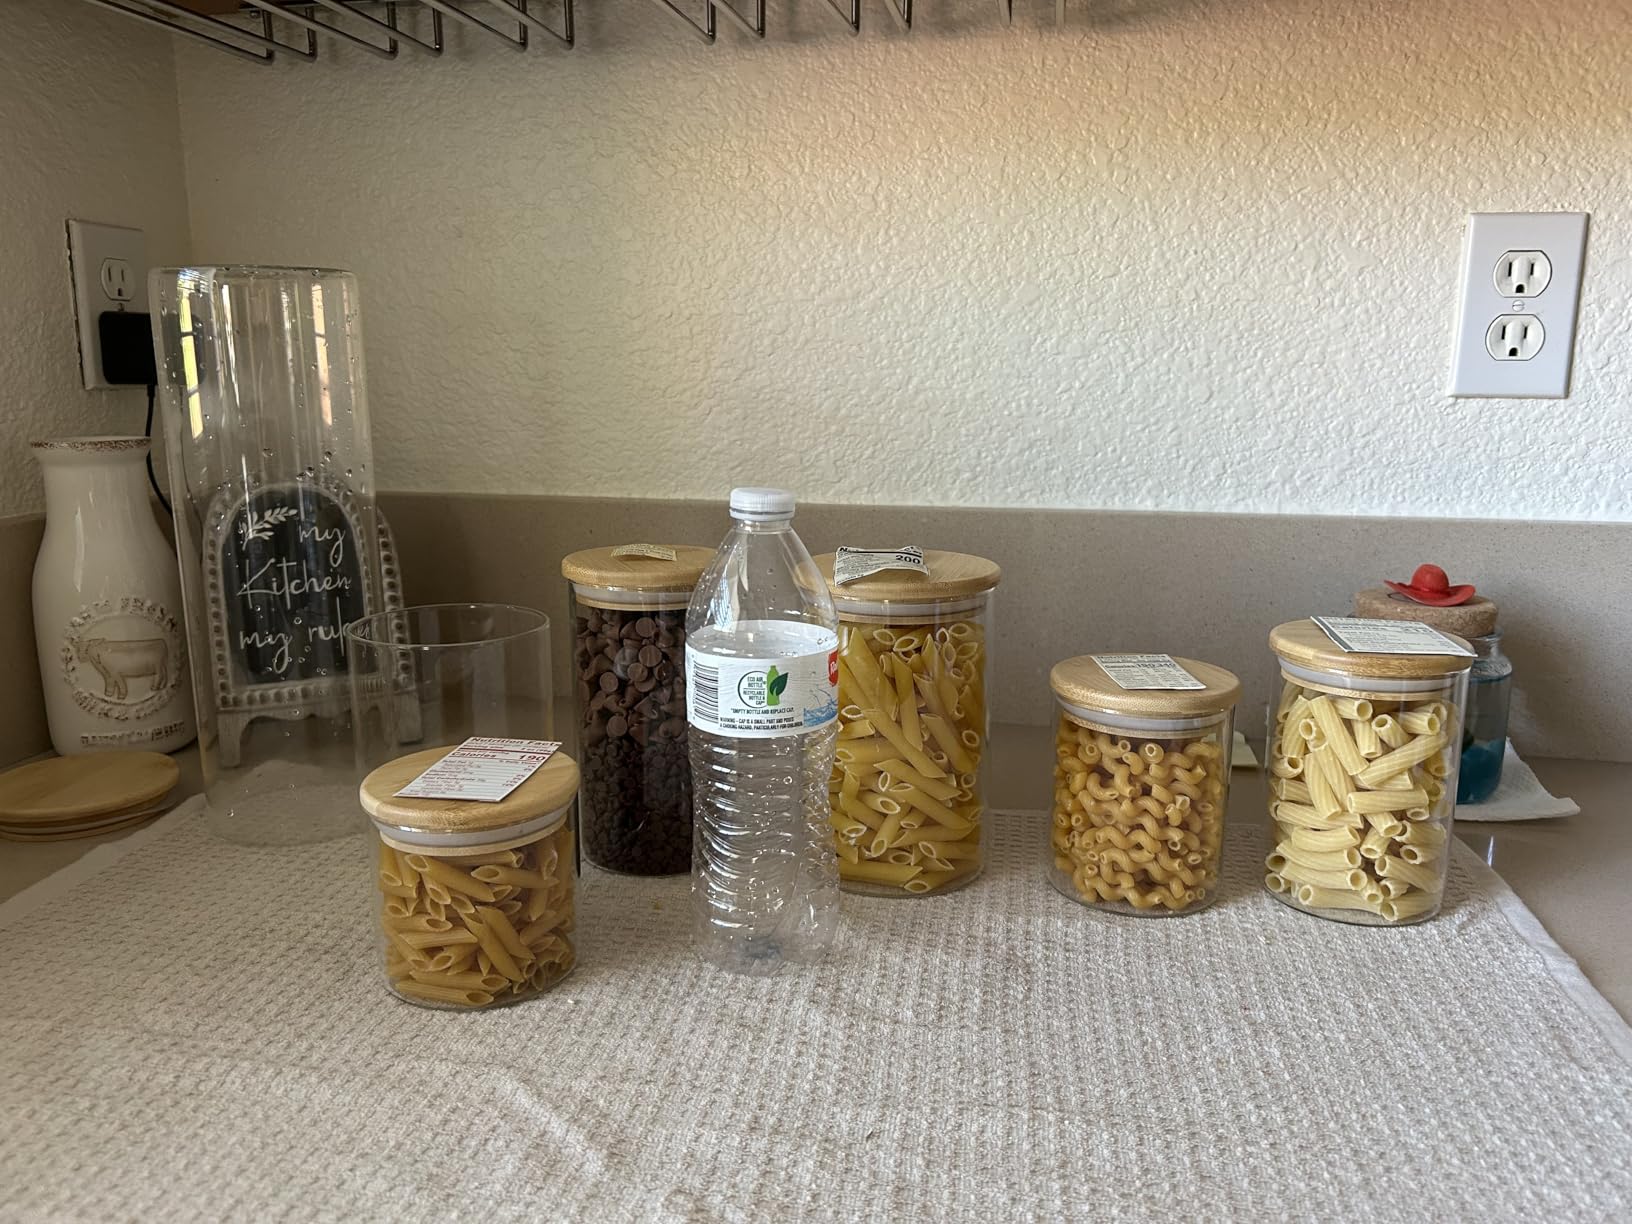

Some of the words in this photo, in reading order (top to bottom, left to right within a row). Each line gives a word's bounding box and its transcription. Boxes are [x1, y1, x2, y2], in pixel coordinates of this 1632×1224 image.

[298, 524, 345, 567] my
[895, 555, 921, 565] 200
[236, 557, 352, 610] Kitchen
[239, 630, 292, 674] my
[471, 737, 523, 745] Nutrition
